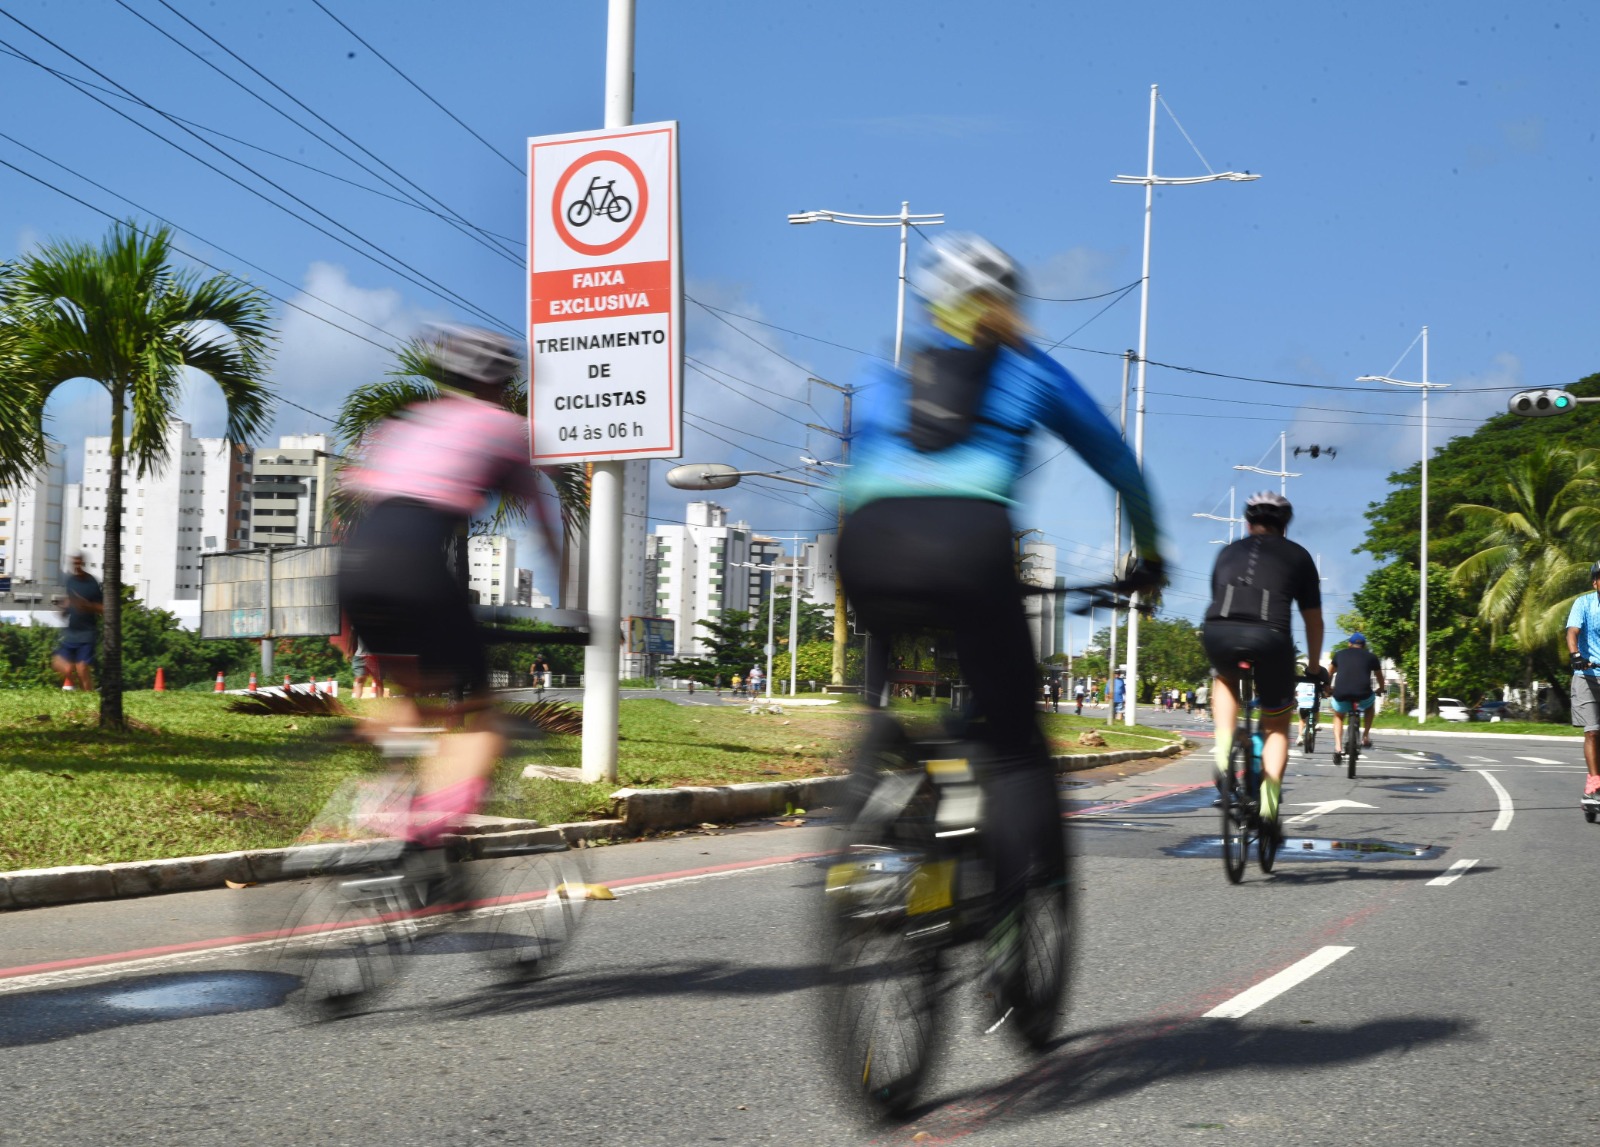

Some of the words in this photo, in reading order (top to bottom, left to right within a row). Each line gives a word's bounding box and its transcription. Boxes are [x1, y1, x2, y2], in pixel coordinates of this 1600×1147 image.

[573, 270, 625, 289] FAIXA
[549, 293, 650, 316] EXCLUSIVA
[536, 329, 665, 353] TREINAMENTO
[588, 363, 611, 379] DE
[554, 390, 646, 411] CICLISTAS
[559, 425, 578, 441] 04
[583, 424, 602, 440] às
[608, 422, 627, 438] 06
[633, 421, 643, 437] h
